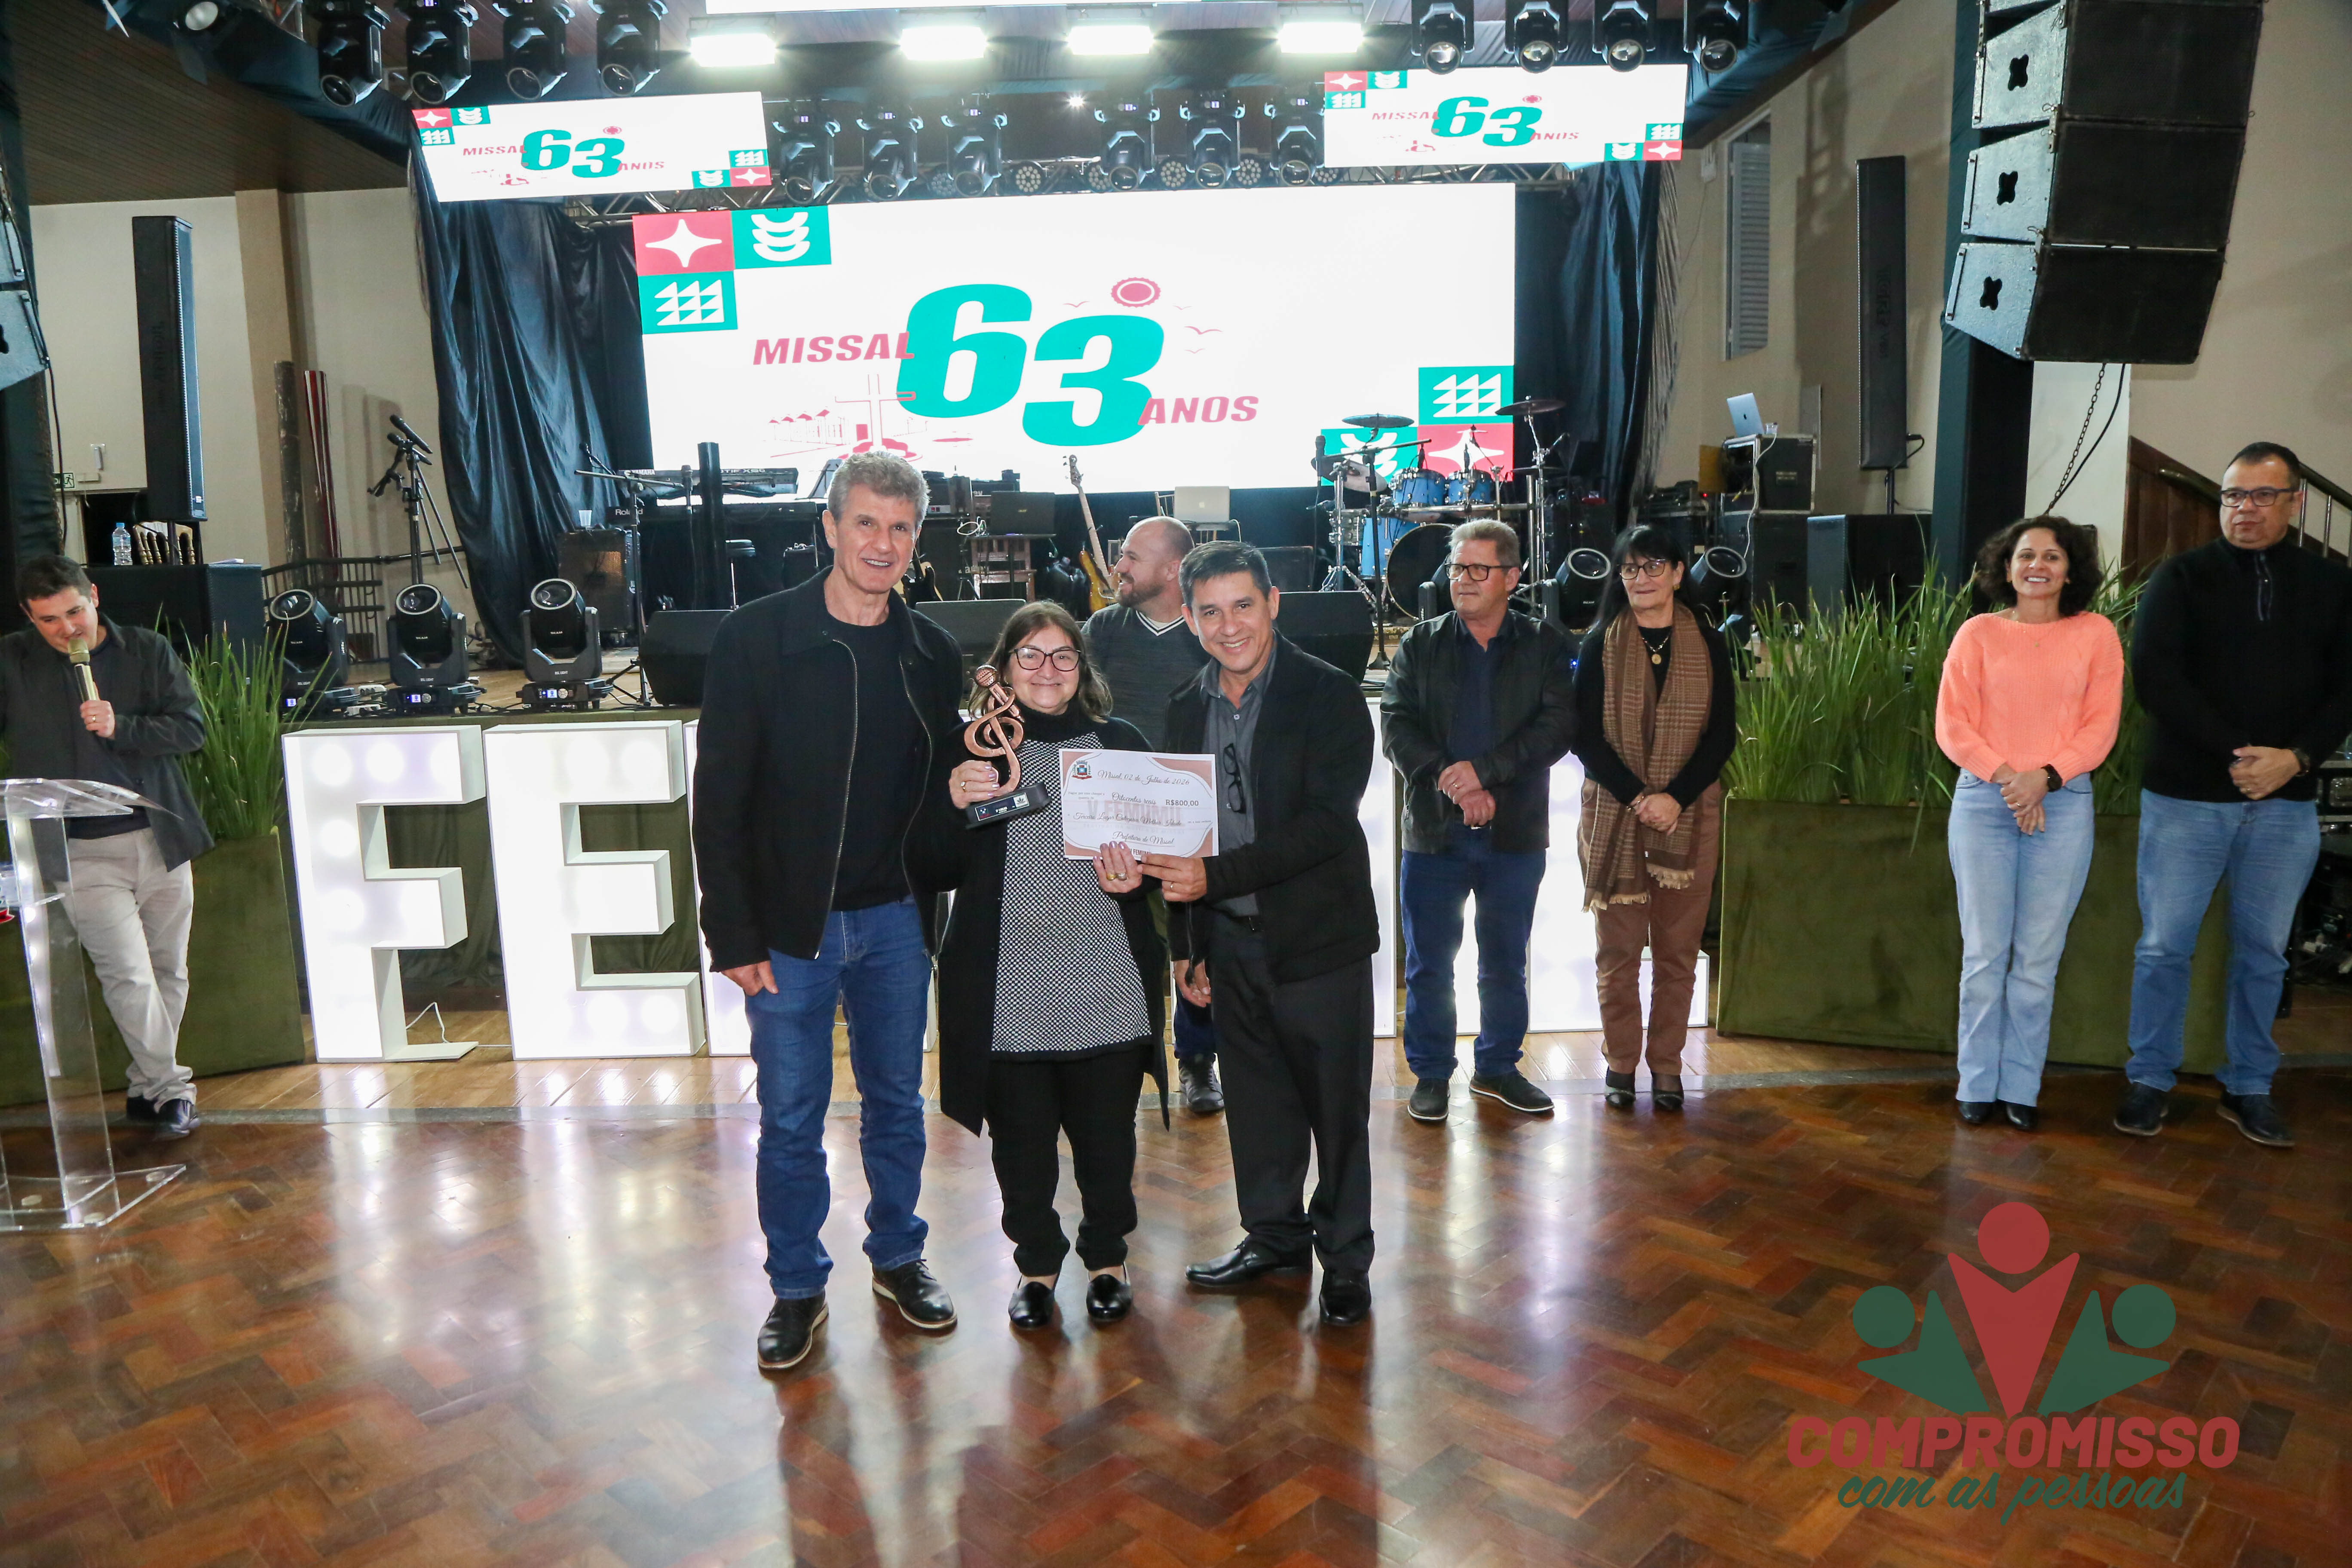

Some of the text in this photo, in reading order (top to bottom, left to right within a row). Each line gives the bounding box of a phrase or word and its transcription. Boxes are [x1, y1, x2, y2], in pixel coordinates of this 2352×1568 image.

[1372, 110, 1440, 120] MISSAL
[1431, 96, 1542, 147] 63
[462, 145, 527, 156] MISSAL
[521, 129, 625, 178] 63
[753, 331, 915, 365] MISSAL
[896, 284, 1164, 447] 63
[1138, 395, 1259, 425] ANOS
[1112, 831, 1141, 842] Prefeitura
[1149, 835, 1175, 845] Missal
